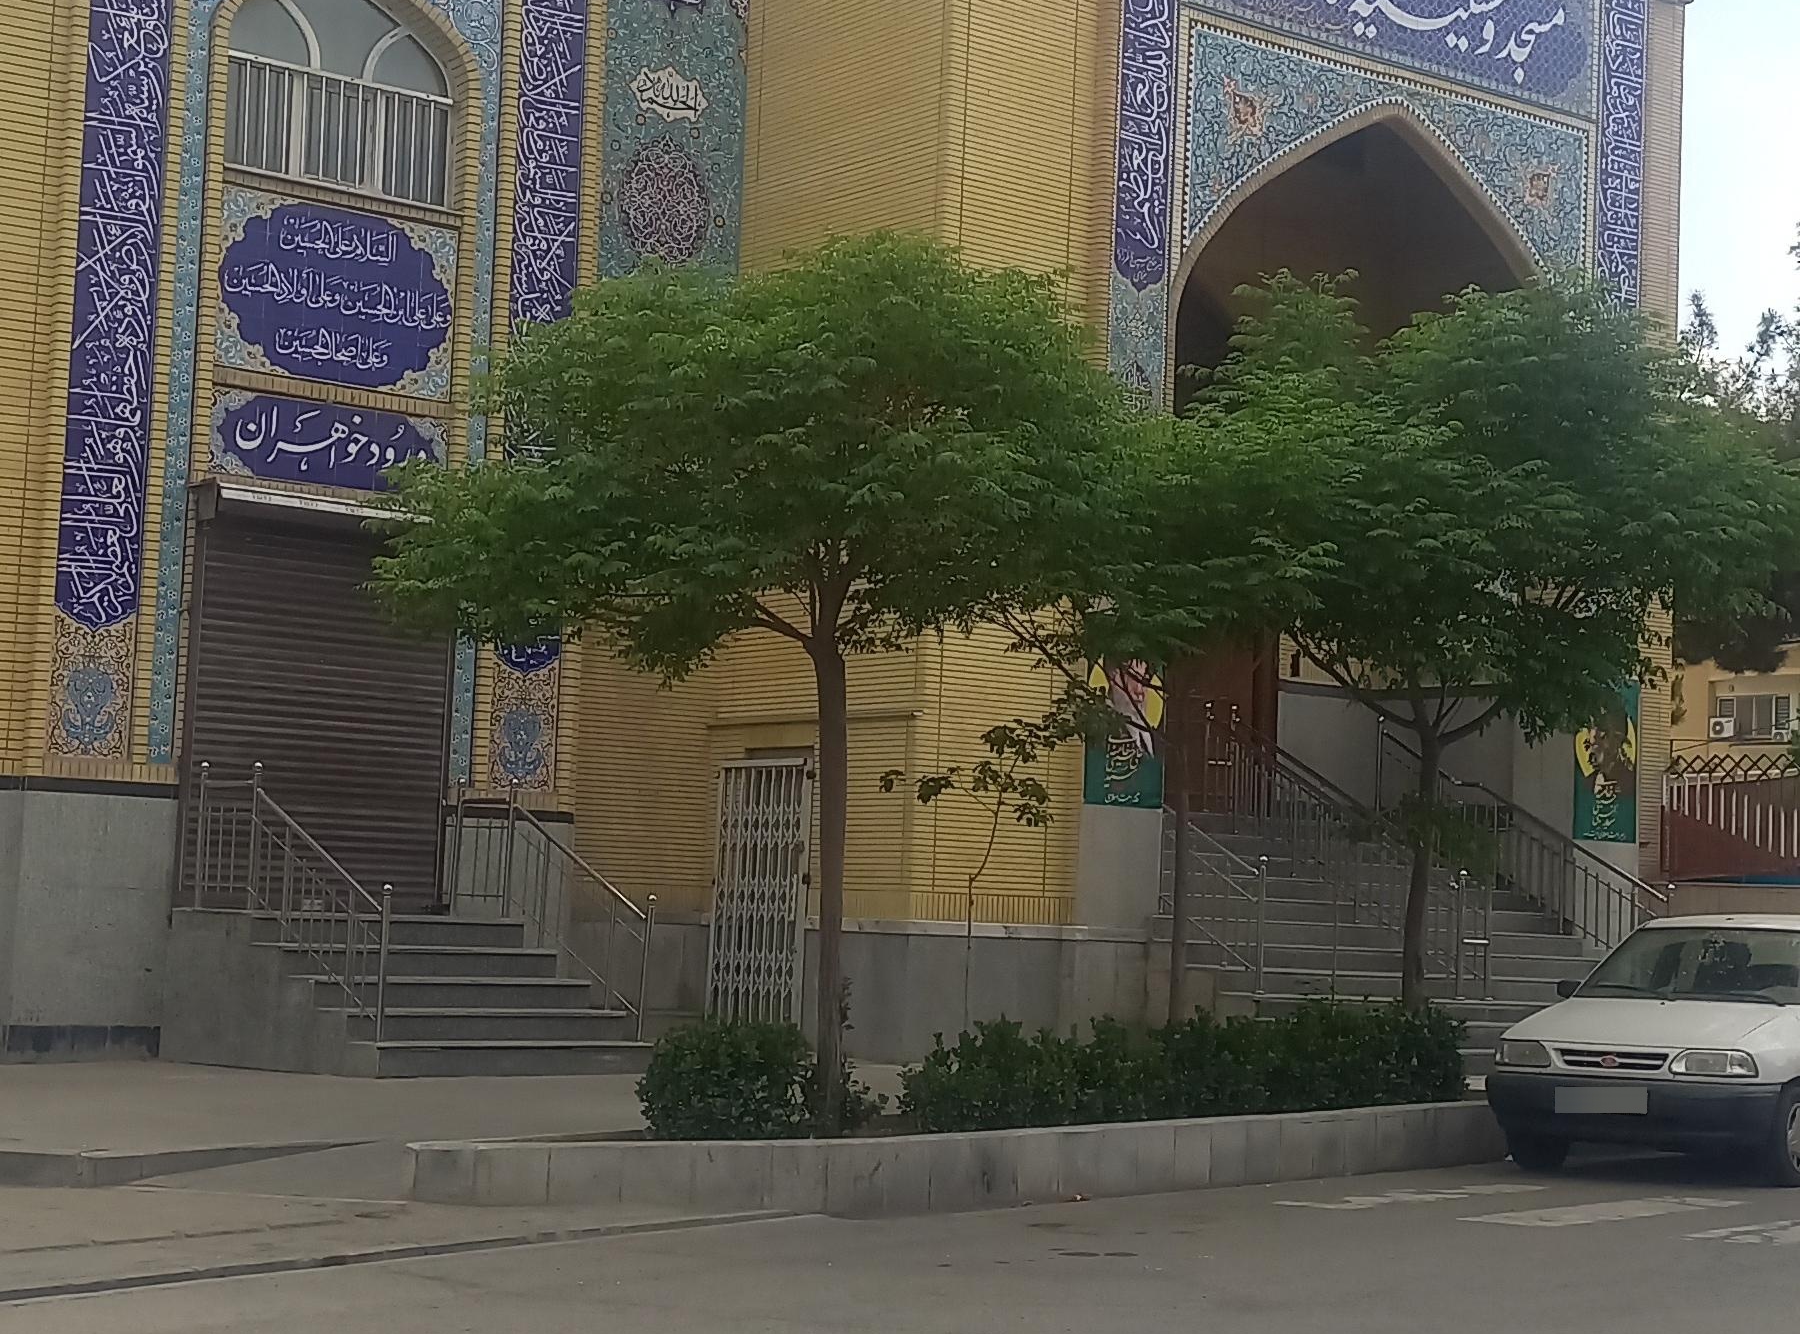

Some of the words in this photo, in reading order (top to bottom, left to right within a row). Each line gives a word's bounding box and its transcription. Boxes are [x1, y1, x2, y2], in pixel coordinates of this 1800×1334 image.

[1474, 17, 1495, 56] و
[1495, 4, 1566, 85] مسجد
[279, 219, 335, 254] الحسین
[224, 262, 281, 293] الحسین
[340, 282, 397, 317] الحسین
[275, 327, 332, 355] الحسین
[235, 405, 369, 471] خواهران
